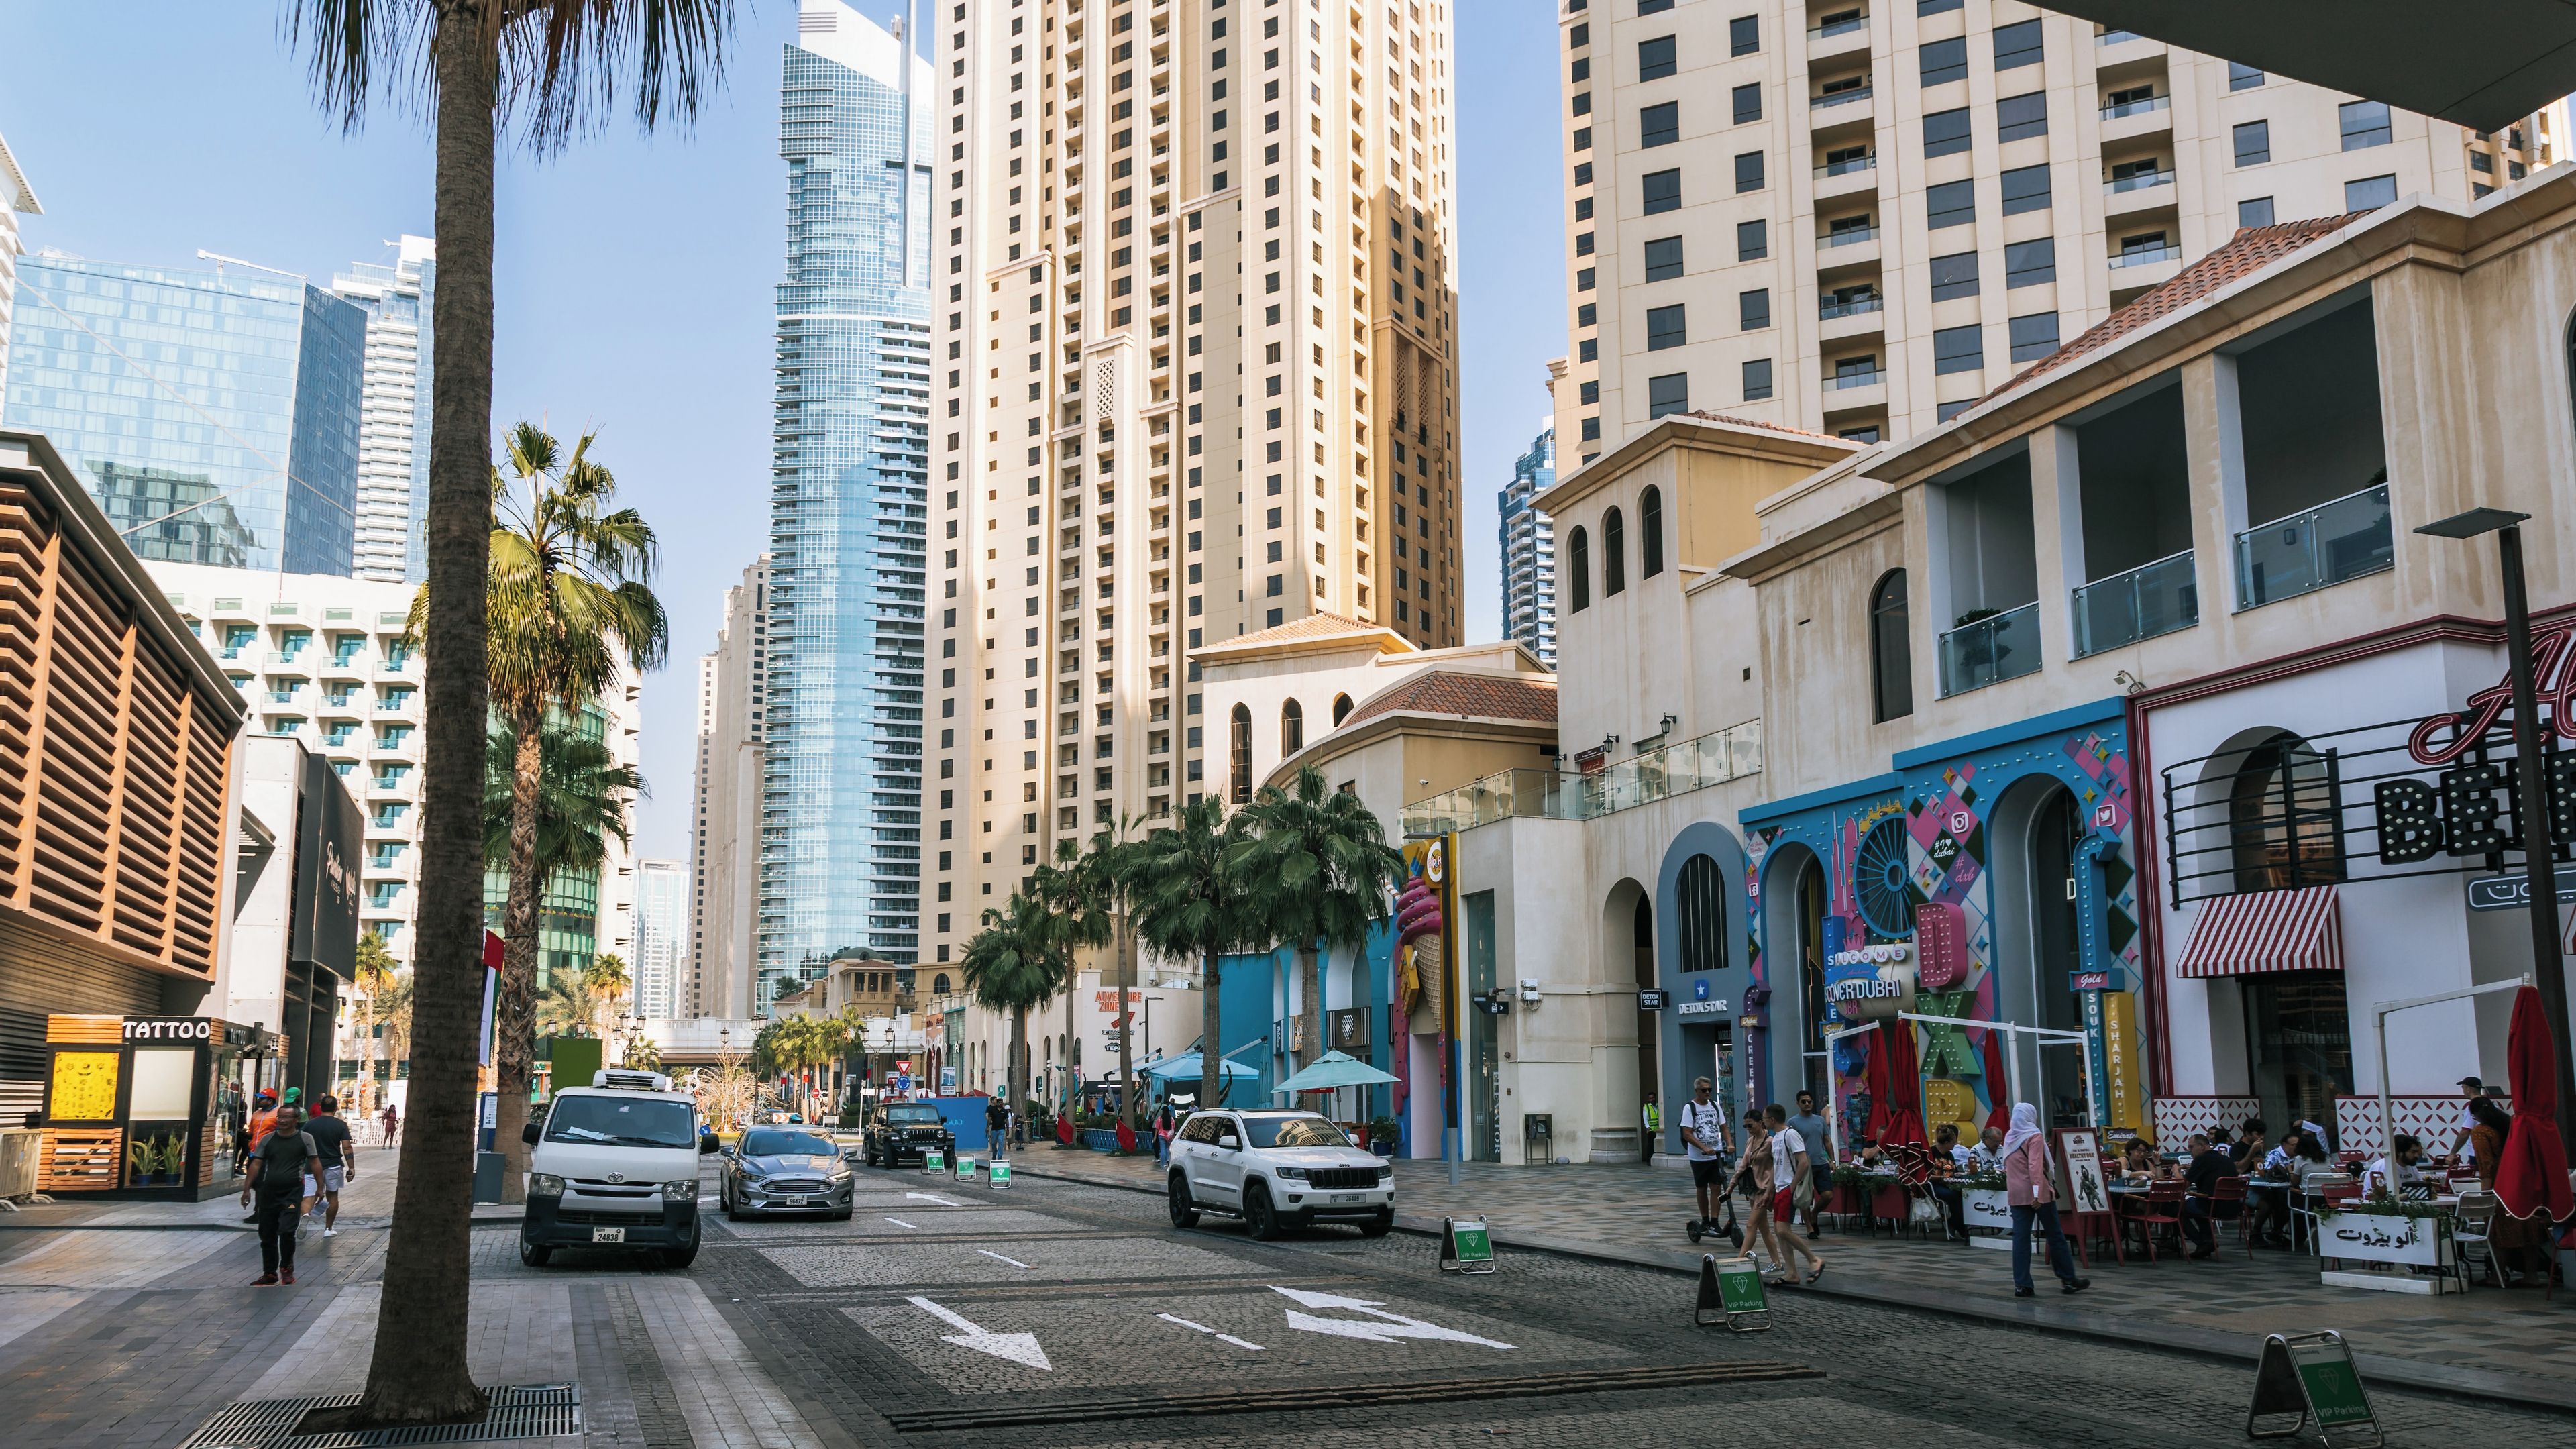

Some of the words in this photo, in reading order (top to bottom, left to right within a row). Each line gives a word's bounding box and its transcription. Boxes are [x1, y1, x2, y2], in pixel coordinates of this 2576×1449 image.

[1934, 847, 1955, 857] dubai
[1955, 867, 1975, 882] dxb
[1856, 979, 1900, 998] DUBAI
[2080, 974, 2102, 987] Gold
[2088, 993, 2098, 1038] SOUK
[122, 1021, 210, 1038] TATTOO
[2110, 1020, 2125, 1098] SHARJAH
[1493, 1072, 1501, 1154] ELEVATOR
[598, 1234, 619, 1242] 24838
[2336, 1229, 2390, 1247] بيروت
[2318, 1409, 2333, 1417] VIP
[2334, 1405, 2367, 1415] Parking
